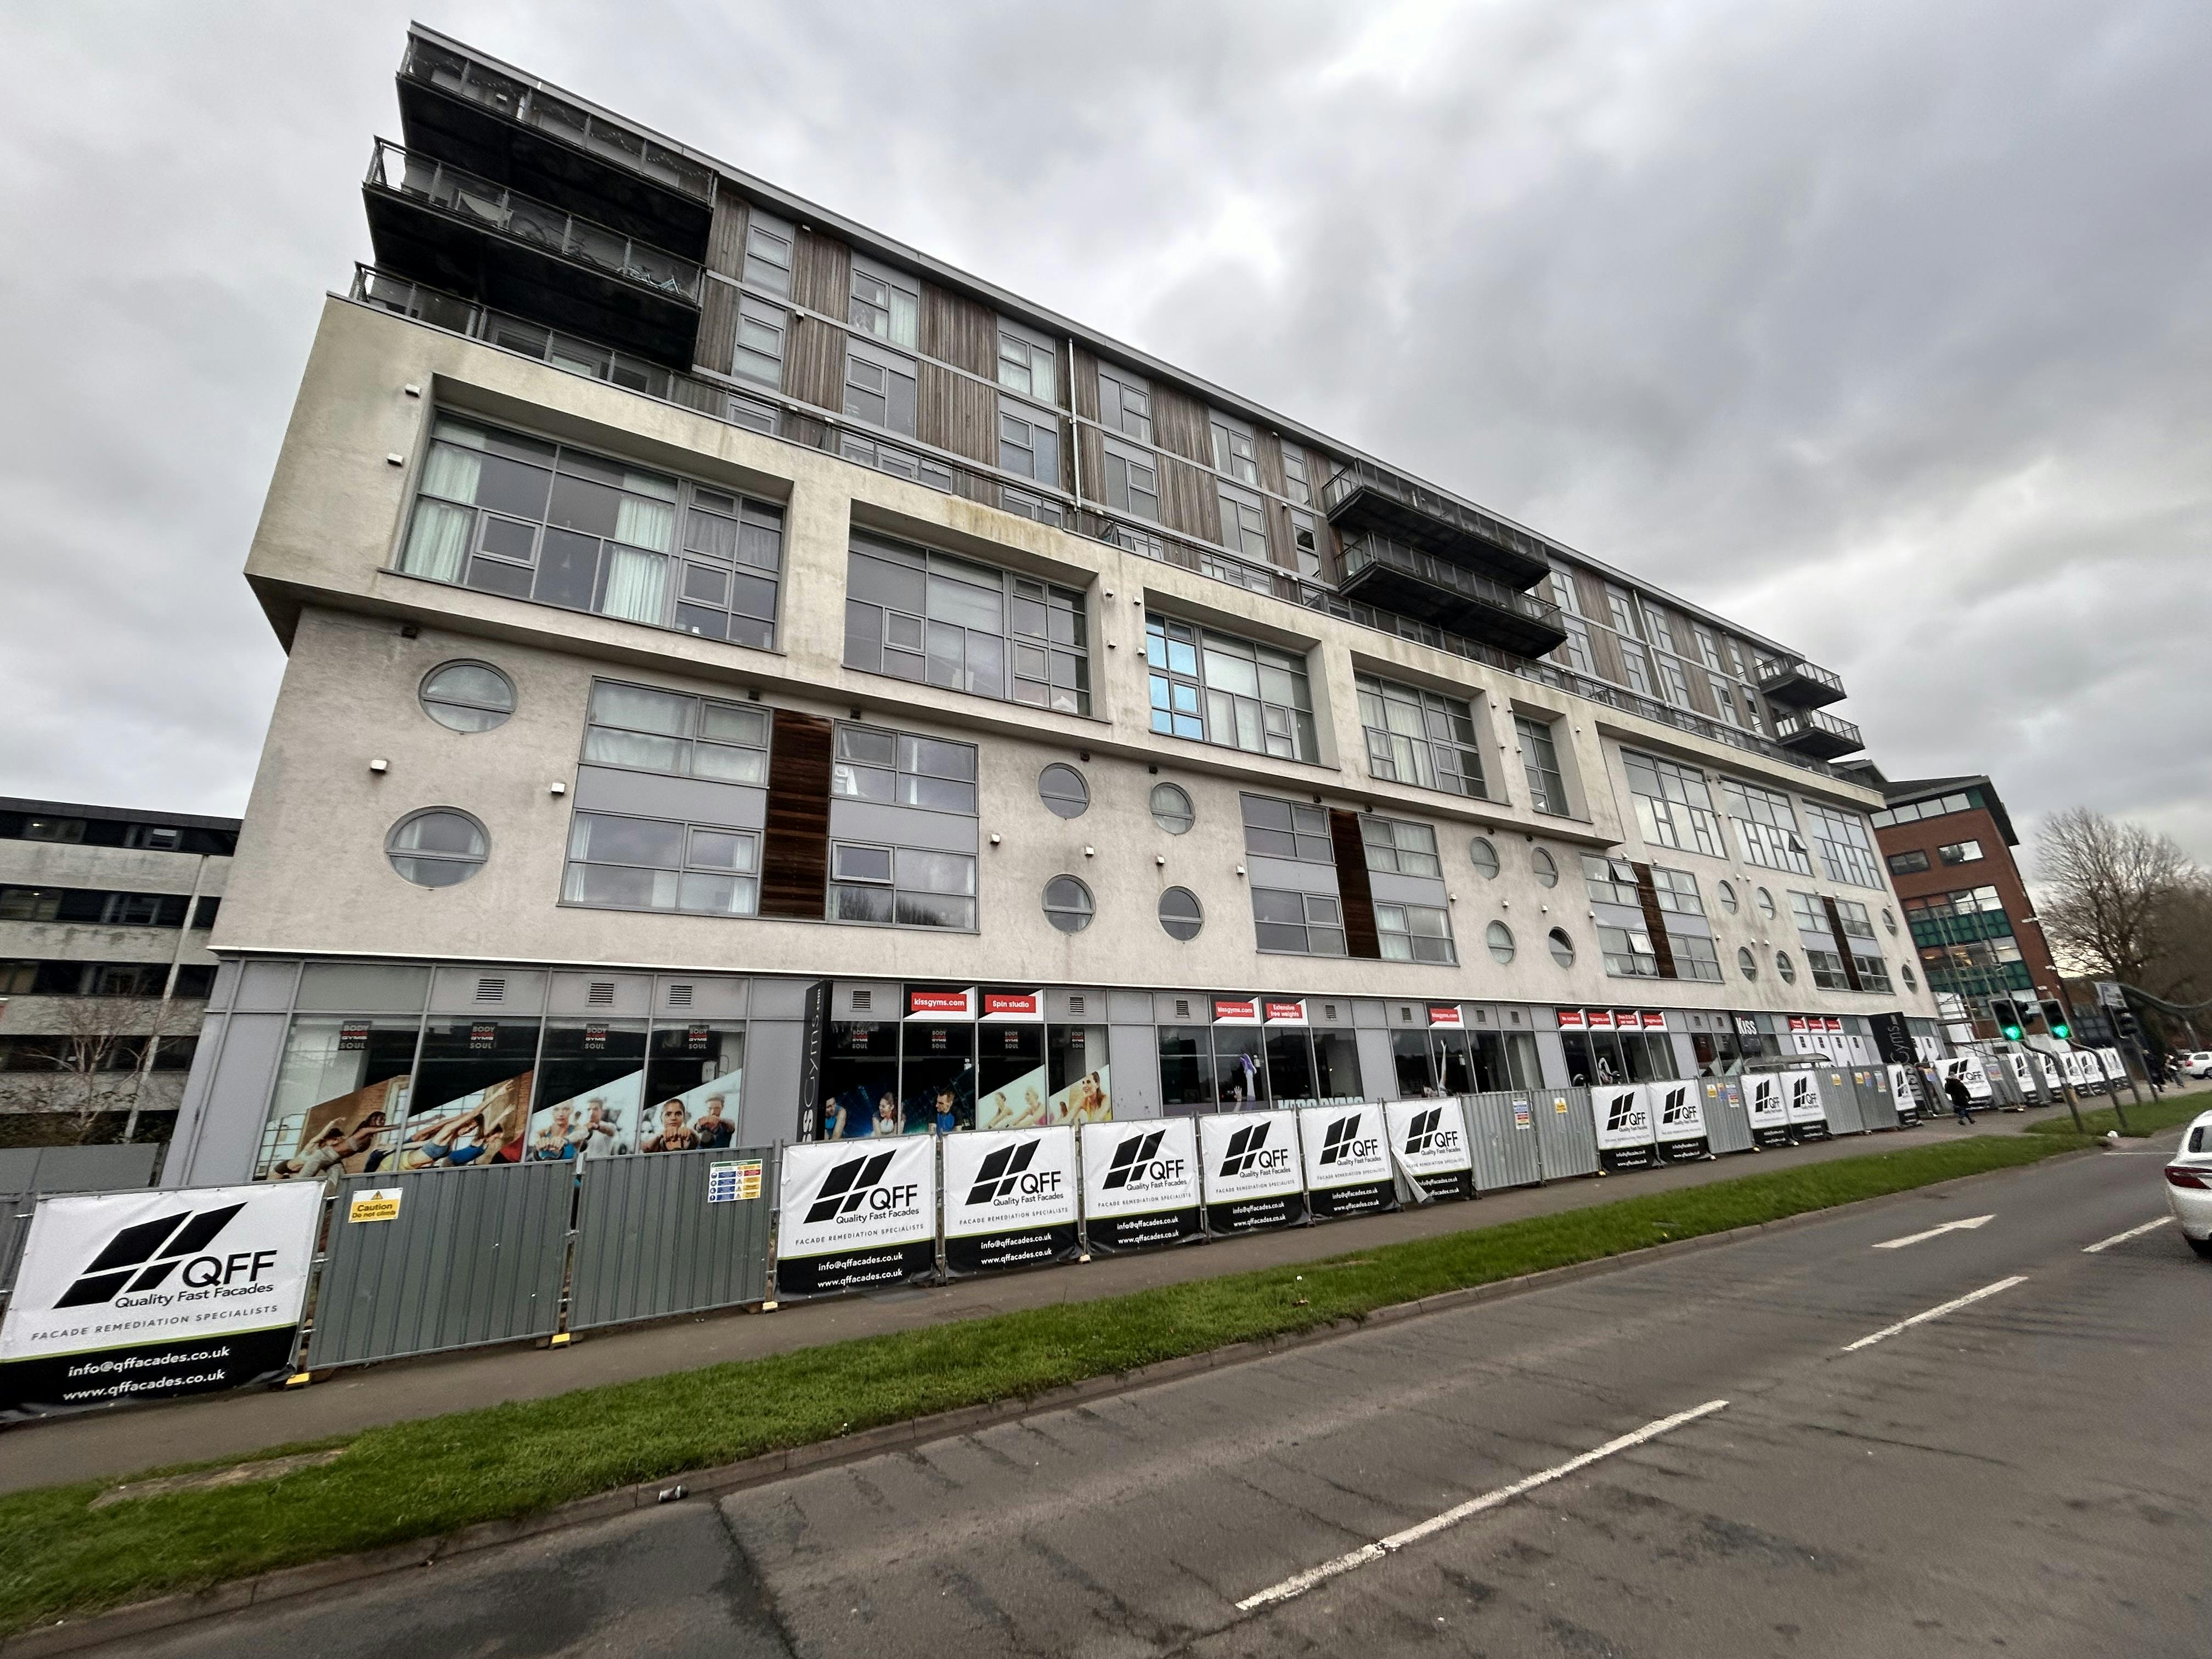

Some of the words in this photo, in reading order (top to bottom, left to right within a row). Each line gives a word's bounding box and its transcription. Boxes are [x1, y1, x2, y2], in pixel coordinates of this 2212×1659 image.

[914, 998, 965, 1007] kissgyms.com
[992, 1000, 1007, 1008] Spin
[1629, 1112, 1645, 1125] QFF
[1682, 1106, 1696, 1119] QFF
[1435, 1131, 1458, 1147] QFF
[1353, 1139, 1378, 1156] QFF
[1259, 1149, 1288, 1168] QFF
[1150, 1159, 1184, 1180] QFF
[1020, 1171, 1061, 1194] QFF
[870, 1184, 917, 1210] QFF
[994, 1198, 1019, 1206] Quality
[357, 1203, 393, 1212] Caution
[837, 1214, 867, 1224] Quality
[870, 1212, 886, 1220] Fast
[889, 1207, 919, 1217] Facades
[988, 1212, 1029, 1222] REMEDIATION
[1032, 1207, 1068, 1216] SPECIALISTS
[1233, 1201, 1284, 1214] info@qffacades.co.uk
[1117, 1216, 1178, 1229] info@qffacades.co.uk
[1234, 1214, 1286, 1226] www.qffacades.co.uk
[795, 1237, 825, 1245] FACADE
[828, 1230, 877, 1240] REMEDIATION
[882, 1224, 923, 1234] SPECIALISTS
[981, 1233, 1051, 1249] info@qffacades.co.uk
[1118, 1229, 1179, 1244] www.qffacades.co.uk
[819, 1252, 902, 1271] info@qffacades.co.uk
[981, 1248, 1052, 1264] www.qffacades.co.uk
[182, 1250, 278, 1288] QFF
[818, 1269, 902, 1288] www.qffacades.co.uk
[115, 1293, 174, 1308] Quality
[177, 1289, 210, 1302] Fast
[214, 1283, 274, 1297] Facades
[31, 1327, 88, 1340] FACADE
[94, 1316, 190, 1333] REMEDIATION
[196, 1305, 278, 1322] SPECIALISTS
[67, 1346, 230, 1378] info@qffacades.co.uk
[63, 1369, 225, 1400] www.qffacades.co.uk
